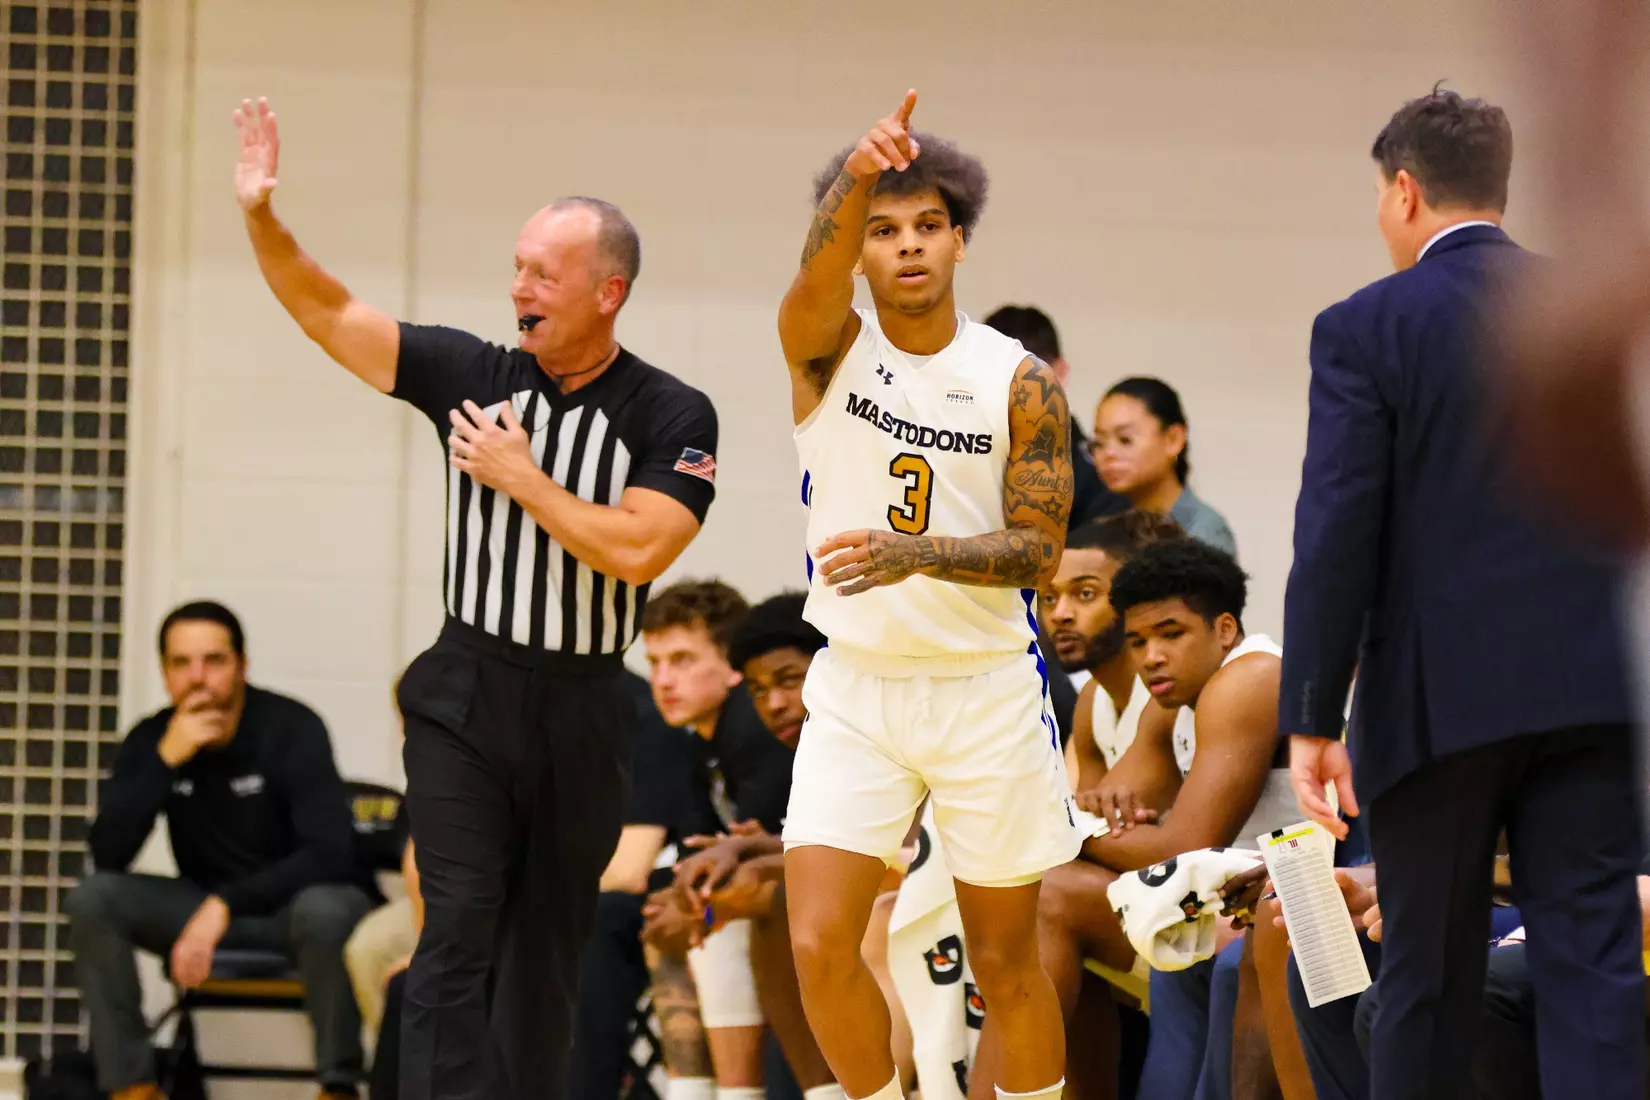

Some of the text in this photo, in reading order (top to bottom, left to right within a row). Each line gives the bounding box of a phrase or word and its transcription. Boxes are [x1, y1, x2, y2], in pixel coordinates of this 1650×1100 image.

[846, 392, 992, 454] MASTODONS
[946, 393, 974, 401] HORIZON
[887, 452, 934, 536] 3
